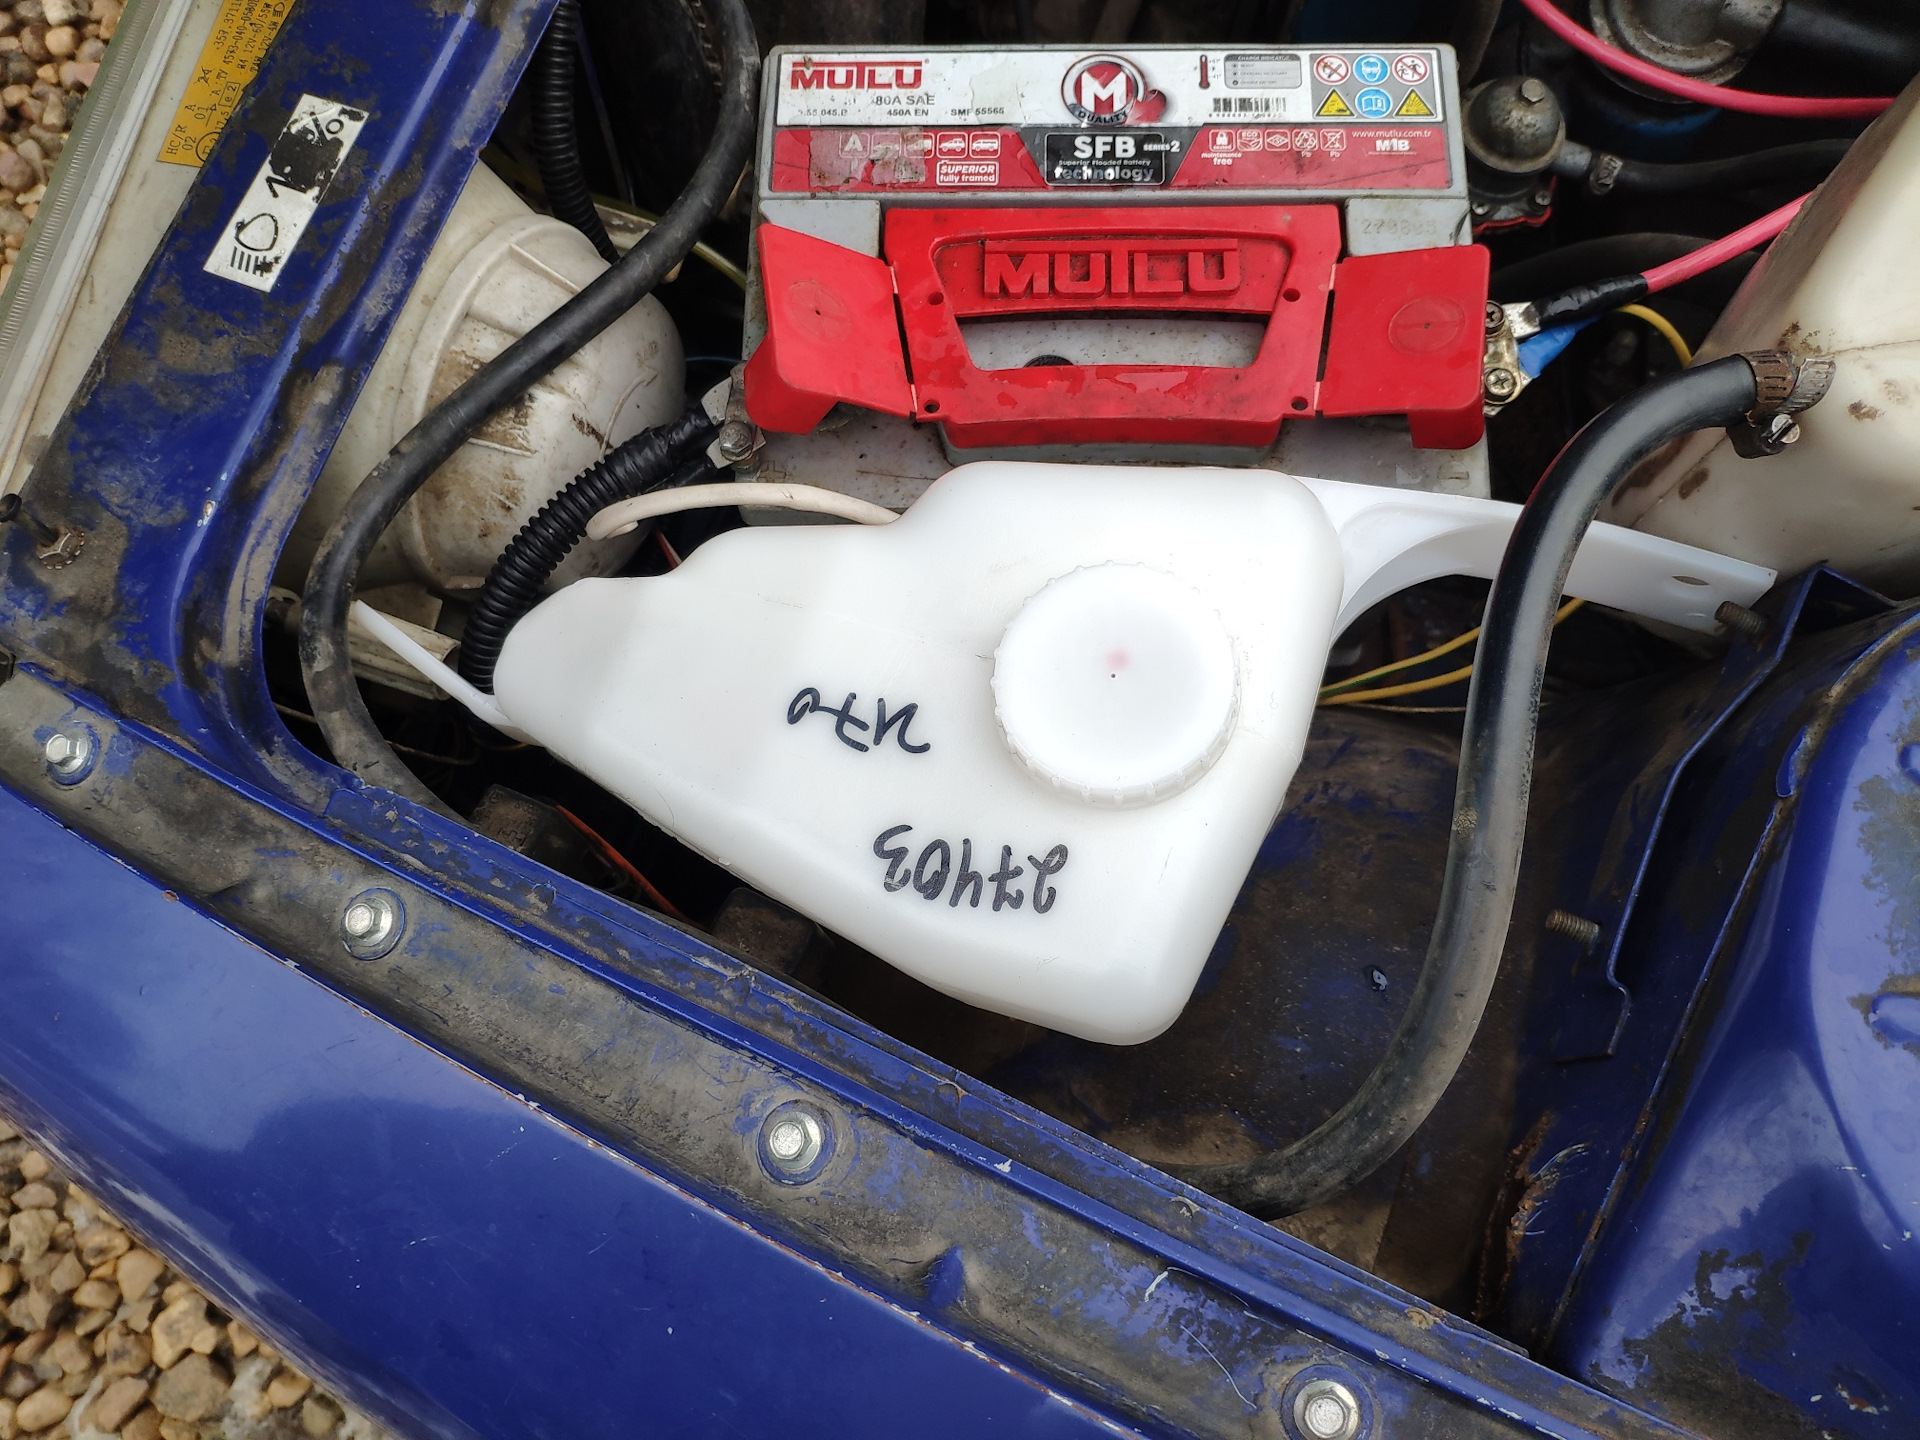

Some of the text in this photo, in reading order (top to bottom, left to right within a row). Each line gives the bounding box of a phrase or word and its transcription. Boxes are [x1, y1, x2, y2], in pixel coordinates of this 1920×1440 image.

[790, 61, 922, 90] MUTLU
[906, 95, 935, 106] SAE
[194, 105, 209, 120] 01
[887, 109, 930, 117] 450A EN
[975, 107, 1005, 115] 55565
[166, 124, 187, 155] HC/R
[1351, 130, 1432, 139] www.mutlu.com.tr
[182, 136, 197, 151] 02
[1073, 135, 1137, 159] SFB
[1170, 140, 1180, 152] 2
[1213, 158, 1233, 166] free
[940, 165, 995, 174] SUPERIOR
[1054, 165, 1154, 182] technology
[940, 173, 995, 183] fully framed
[983, 238, 1240, 299] MUTLU
[872, 824, 1069, 914] 27403
